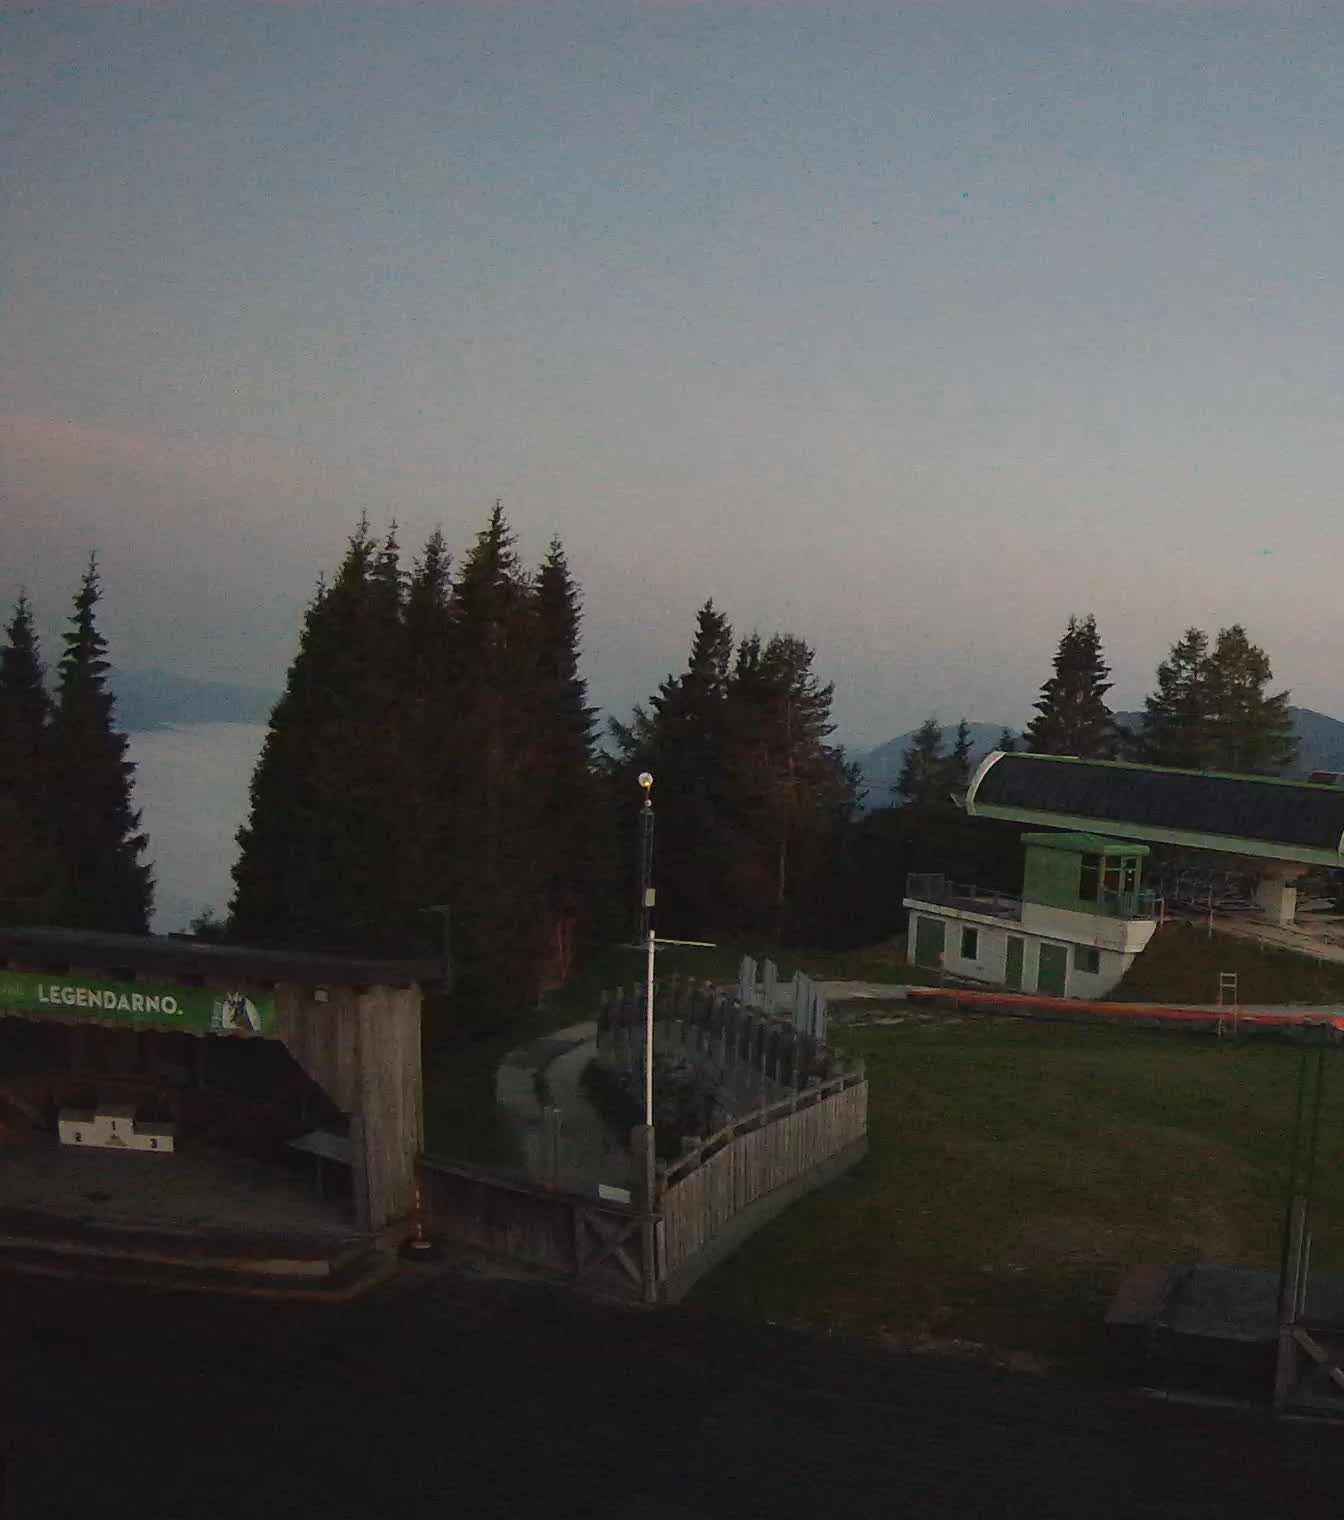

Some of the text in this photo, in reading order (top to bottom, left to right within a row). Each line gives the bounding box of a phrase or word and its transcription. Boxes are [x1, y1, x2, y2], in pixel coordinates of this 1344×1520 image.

[37, 983, 184, 1015] LEGENDARNO.
[74, 1131, 83, 1143] 2
[149, 1137, 158, 1149] 3
